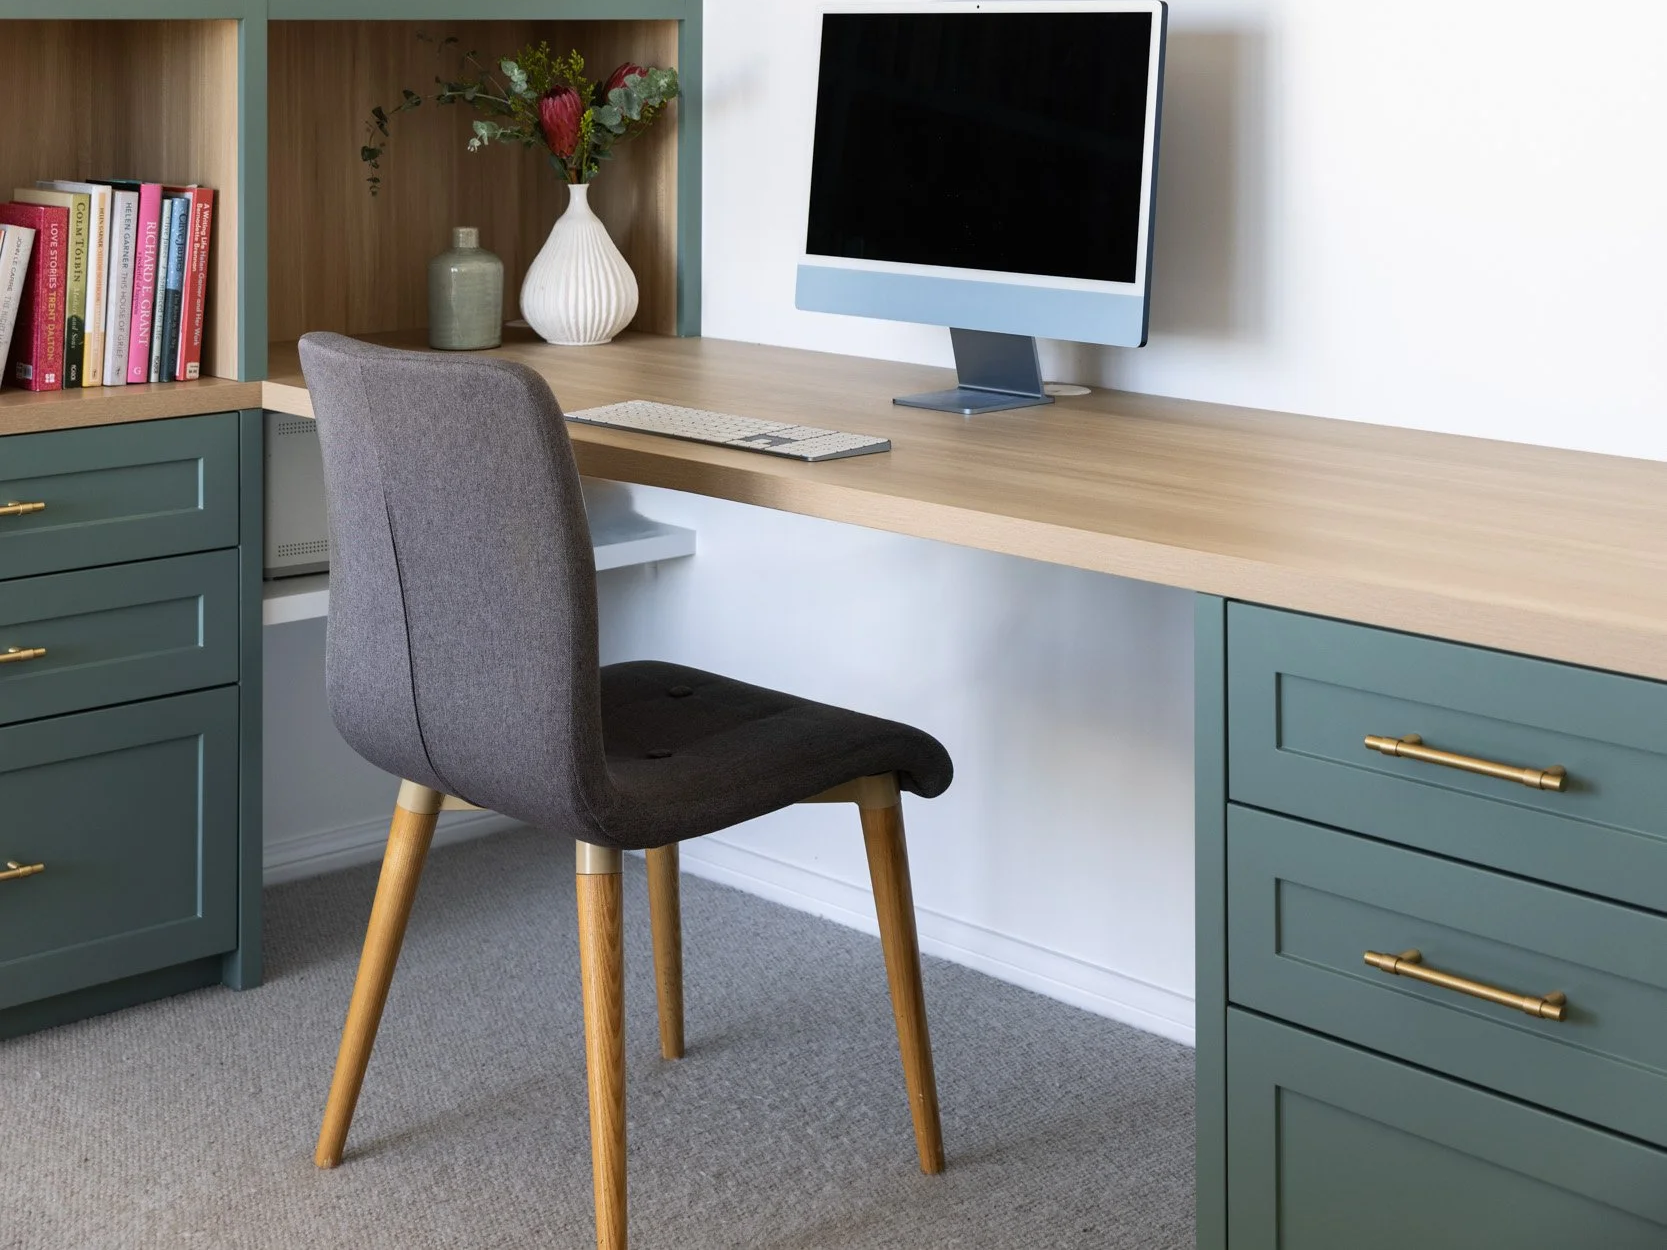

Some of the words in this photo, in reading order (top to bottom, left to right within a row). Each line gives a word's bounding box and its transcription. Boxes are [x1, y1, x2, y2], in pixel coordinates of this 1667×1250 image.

[75, 202, 86, 237] COLM
[124, 202, 132, 231] HELEN
[178, 213, 187, 240] Clive
[194, 203, 203, 241] Bernadette
[200, 210, 209, 236] Writing
[14, 236, 22, 255] JOHN
[122, 233, 130, 268] GARNER
[142, 221, 157, 282] RICHARD
[175, 240, 185, 272] James
[200, 237, 208, 249] Life
[13, 257, 18, 266] LE
[48, 250, 57, 289] STORIES
[74, 238, 86, 282] TÓIBÍN
[120, 272, 128, 289] THIS
[141, 285, 152, 296] E.
[197, 273, 205, 298] Garner
[48, 291, 56, 321] TRENT
[119, 291, 128, 318] HOUSE
[71, 317, 80, 331] and
[118, 321, 126, 332] OF
[138, 299, 152, 347] GRANT
[193, 327, 201, 346] Work
[47, 324, 55, 360] DALTON
[71, 332, 79, 349] Sons
[117, 334, 125, 358] GRIEF
